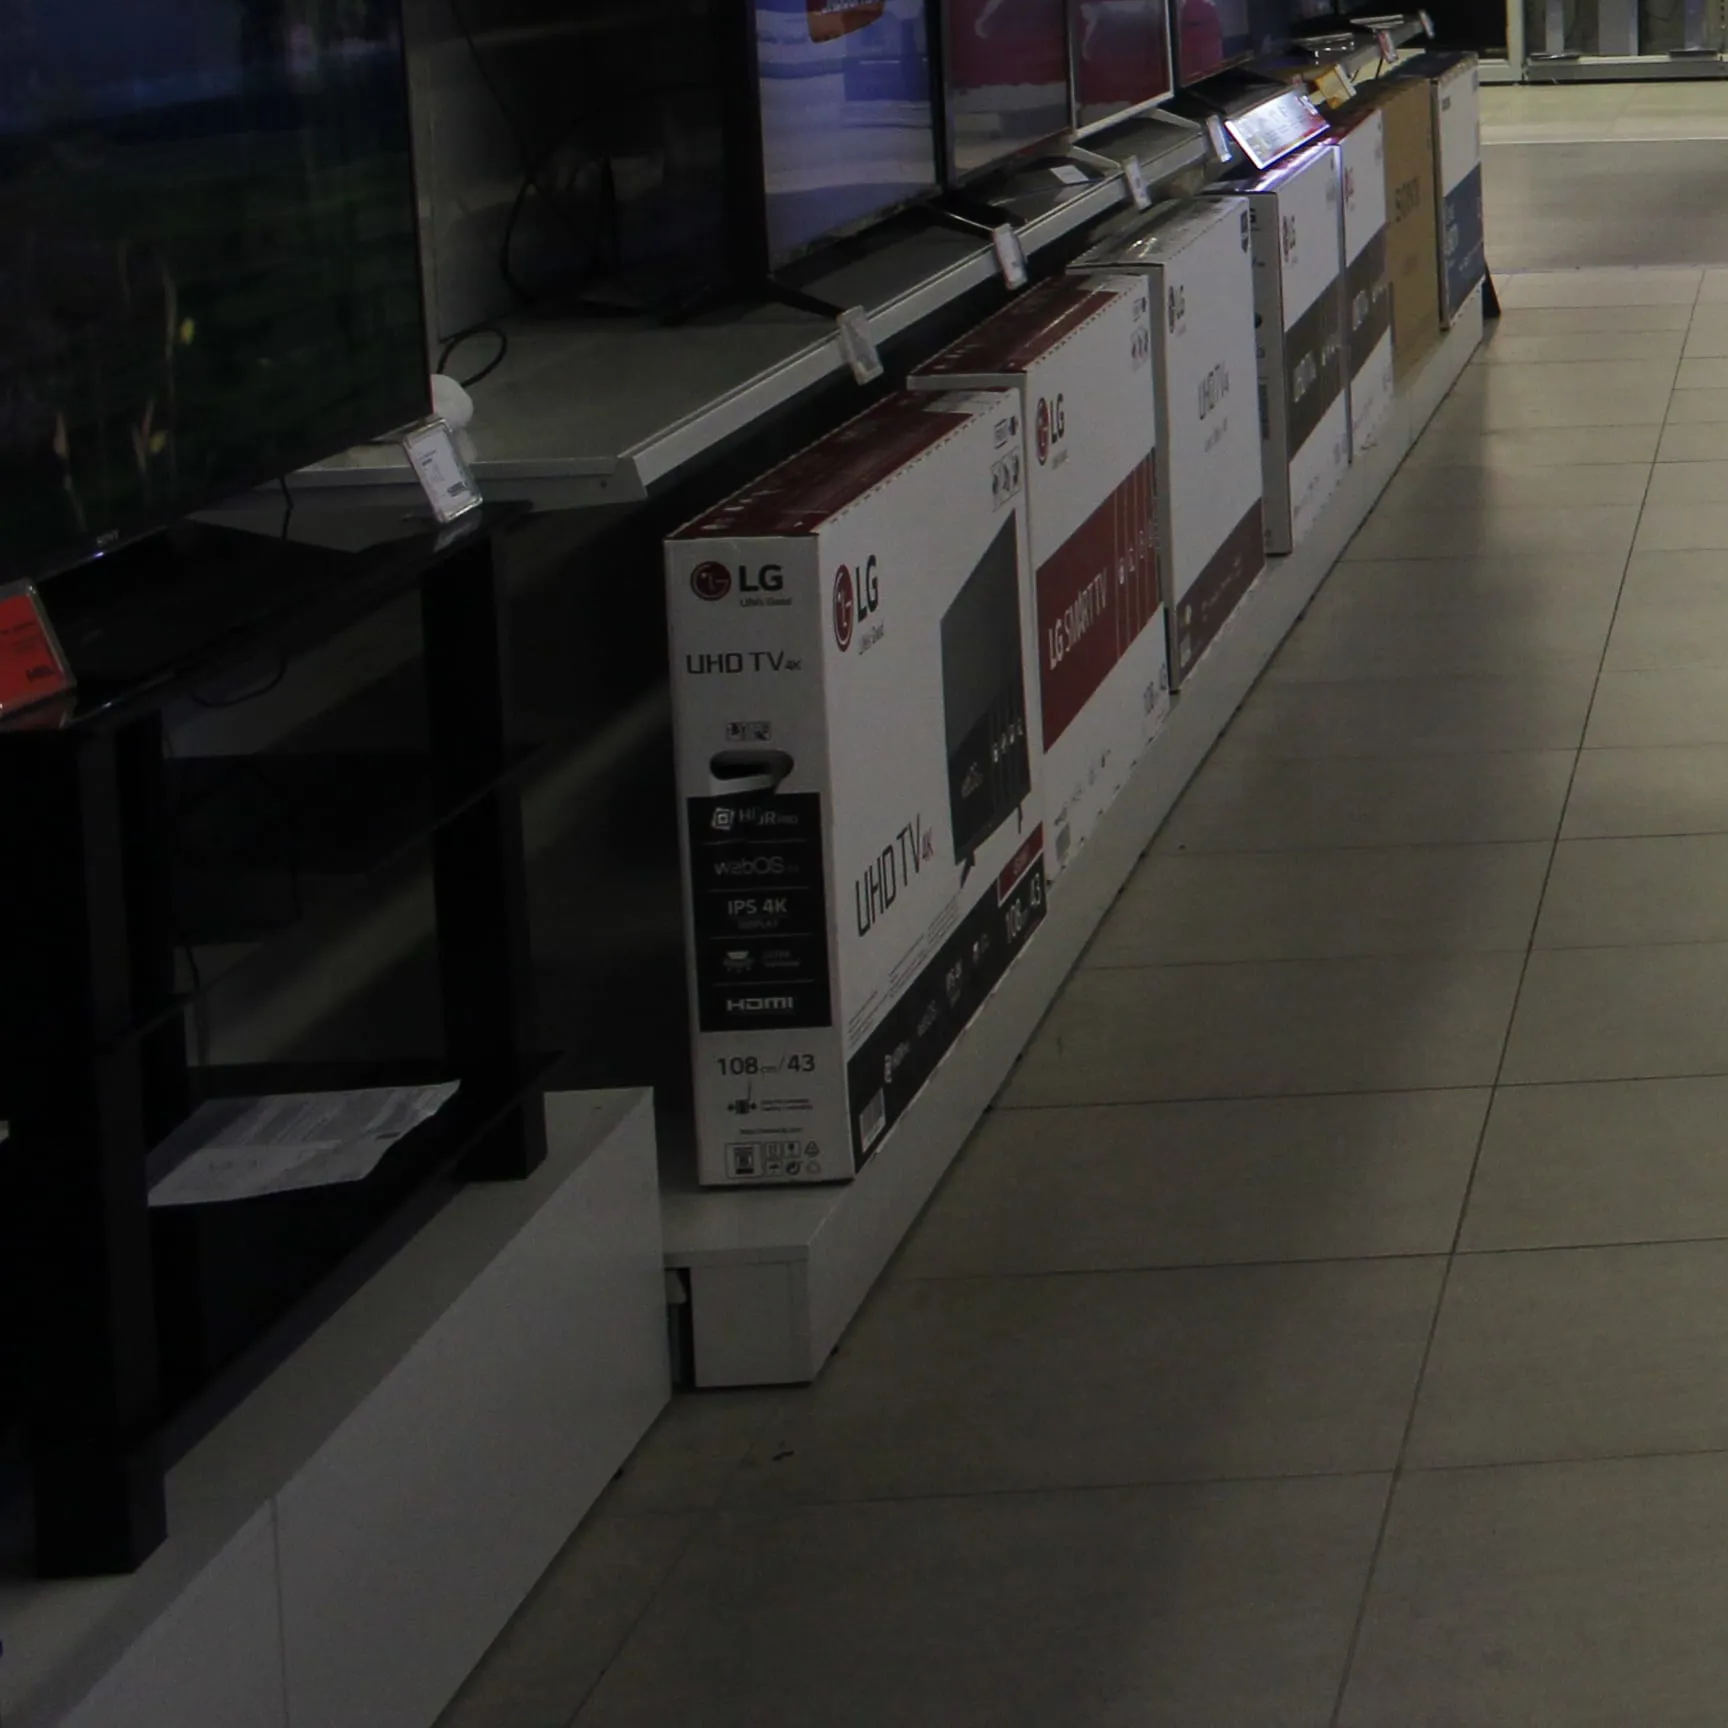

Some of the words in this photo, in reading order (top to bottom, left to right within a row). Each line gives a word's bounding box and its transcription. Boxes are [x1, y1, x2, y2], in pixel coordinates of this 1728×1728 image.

[738, 564, 784, 593] LG
[856, 554, 878, 623] LG
[686, 652, 743, 674] UHD
[748, 650, 785, 673] TV
[713, 855, 785, 876] webOS
[856, 844, 897, 937] UHD
[896, 813, 920, 887] TV
[727, 899, 758, 916] IPS
[762, 897, 788, 914] 4K
[726, 995, 794, 1012] HDMI
[716, 1056, 759, 1076] 108
